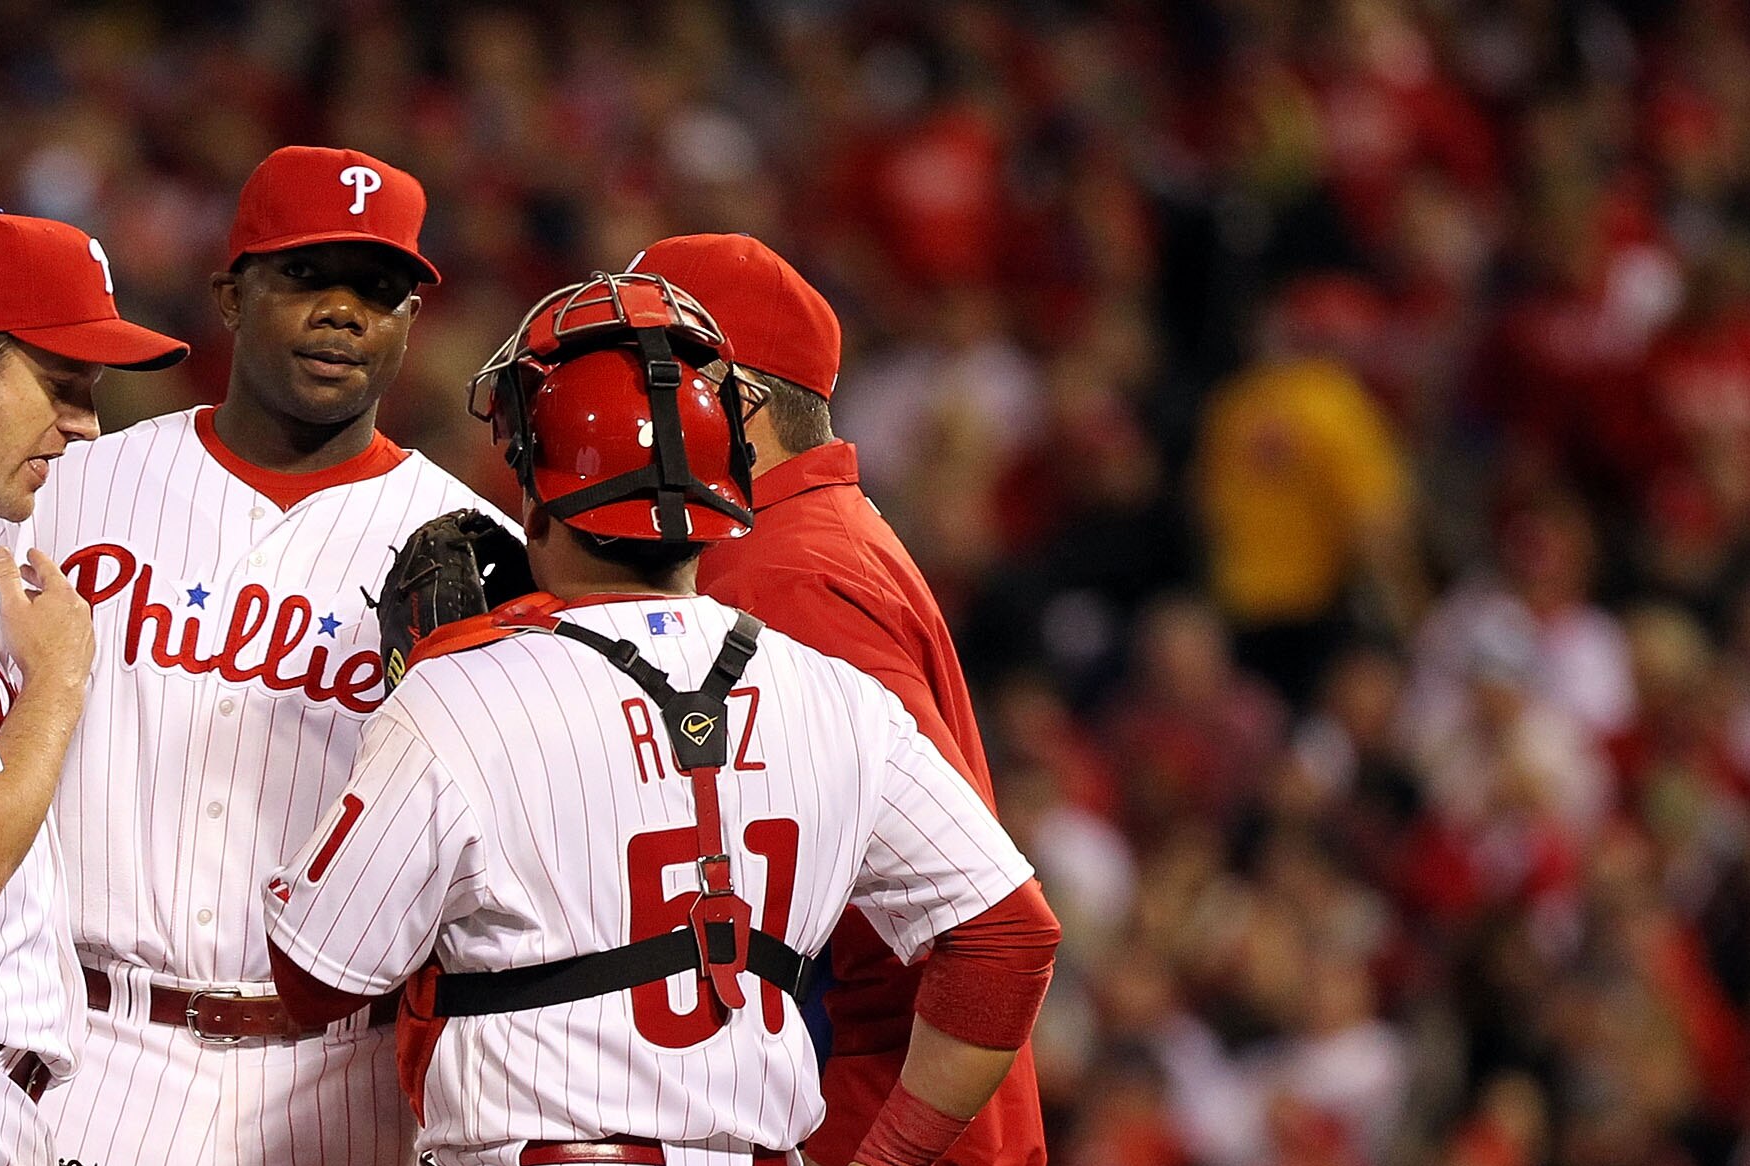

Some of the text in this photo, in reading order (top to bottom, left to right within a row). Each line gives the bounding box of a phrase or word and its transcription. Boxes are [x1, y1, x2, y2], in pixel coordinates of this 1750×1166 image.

[339, 165, 382, 215] P
[60, 543, 384, 714] Phillie
[620, 686, 767, 784] RZ
